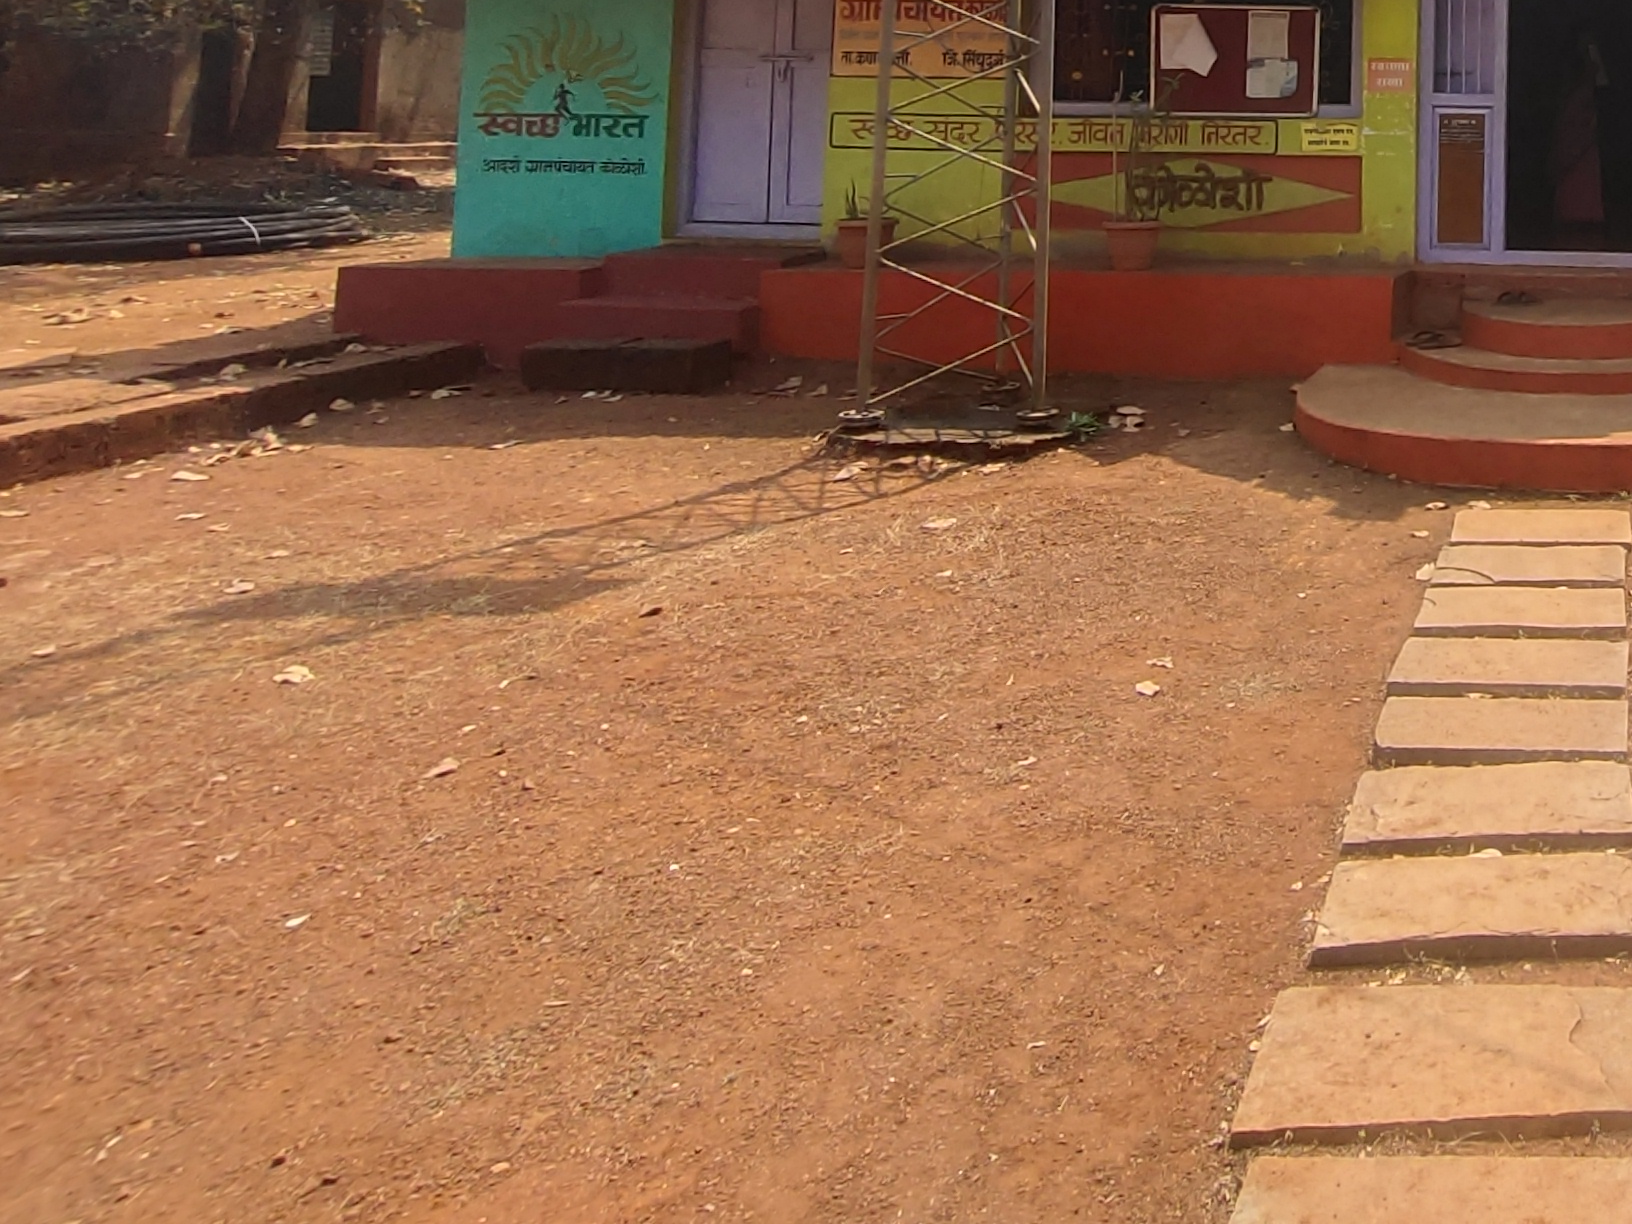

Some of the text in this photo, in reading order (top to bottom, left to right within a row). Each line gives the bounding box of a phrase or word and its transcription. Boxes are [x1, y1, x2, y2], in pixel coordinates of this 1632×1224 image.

[473, 112, 649, 138] स्वच्छ भारत
[525, 157, 597, 175] ग्रामपंचायत
